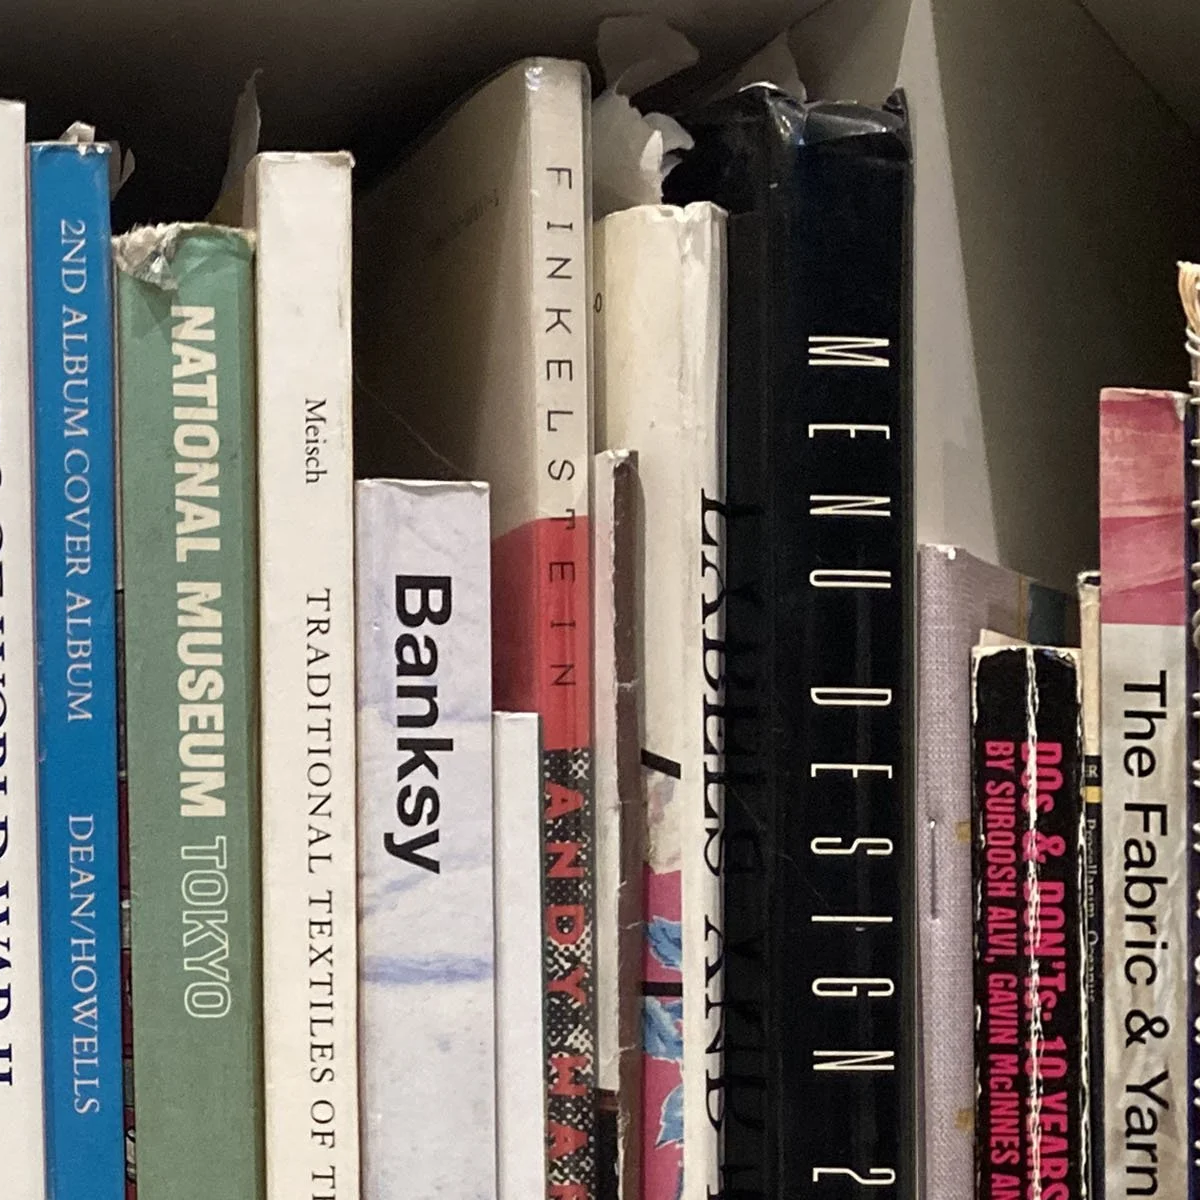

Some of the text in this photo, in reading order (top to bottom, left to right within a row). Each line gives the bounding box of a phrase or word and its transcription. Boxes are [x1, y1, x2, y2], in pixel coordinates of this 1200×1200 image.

[61, 220, 92, 720] 2ND ALBUM COVER ALBUM
[305, 399, 327, 483] Meisch
[544, 166, 576, 687] FINKELSTEIN
[170, 305, 231, 1018] NATIONAL MUSEUM TOKYO
[307, 588, 332, 873] TRADITIONAL
[384, 575, 453, 874] Banksy
[808, 336, 895, 1184] MENU DESIGN 2
[985, 741, 1014, 770] BY
[1124, 670, 1167, 777] The
[542, 782, 587, 1005] ANDY
[985, 781, 1016, 897] SUROOSH
[1022, 831, 1065, 863] &
[1124, 803, 1168, 986] Fabric
[69, 816, 99, 1113] DEAN/HOWELLS
[309, 890, 334, 1083] TEXTILES
[986, 906, 1017, 962] ALVI,
[988, 973, 1018, 1044] GAVIN
[1025, 1037, 1066, 1079] 10
[1125, 1009, 1169, 1048] &
[311, 1100, 335, 1148] OF
[989, 1054, 1020, 1165] McINNES
[1125, 1070, 1170, 1196] Yarn
